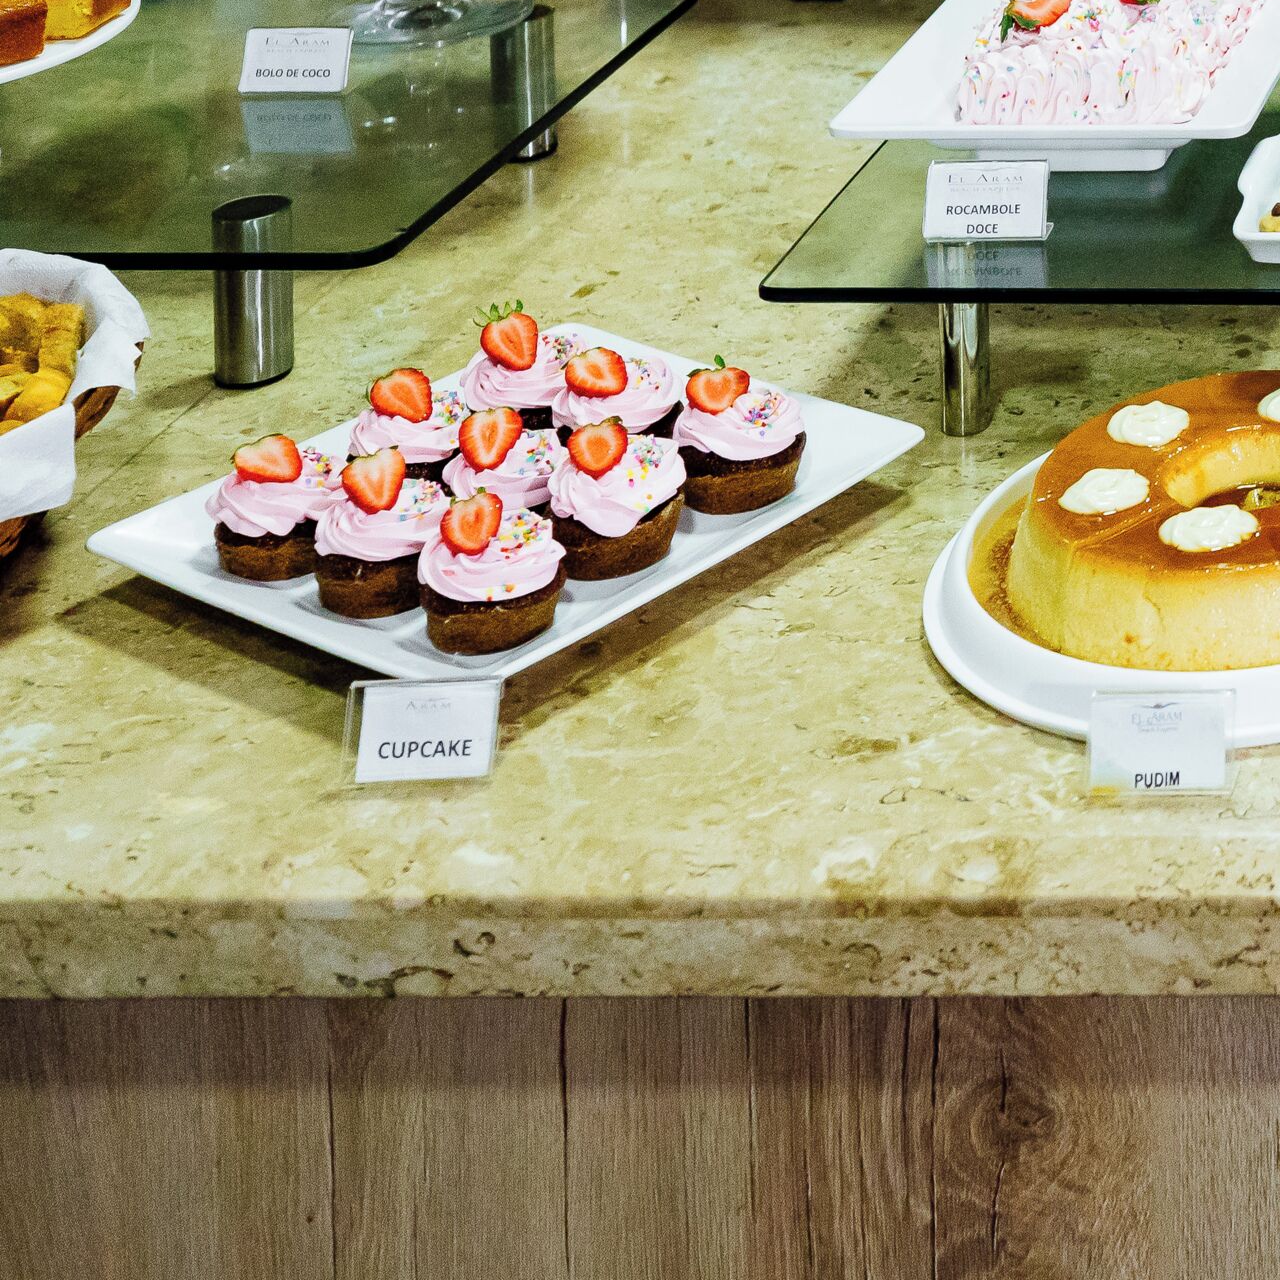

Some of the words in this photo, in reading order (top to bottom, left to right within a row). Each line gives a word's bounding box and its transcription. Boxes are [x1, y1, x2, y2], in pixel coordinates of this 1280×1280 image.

[255, 68, 284, 78] BOLO
[285, 68, 299, 78] DE
[301, 68, 331, 78] COCO
[946, 204, 1021, 216] ROCAMBOLE
[966, 223, 999, 234] DOCE
[378, 739, 473, 760] CUPCAKE
[1134, 771, 1181, 789] PUDIM
